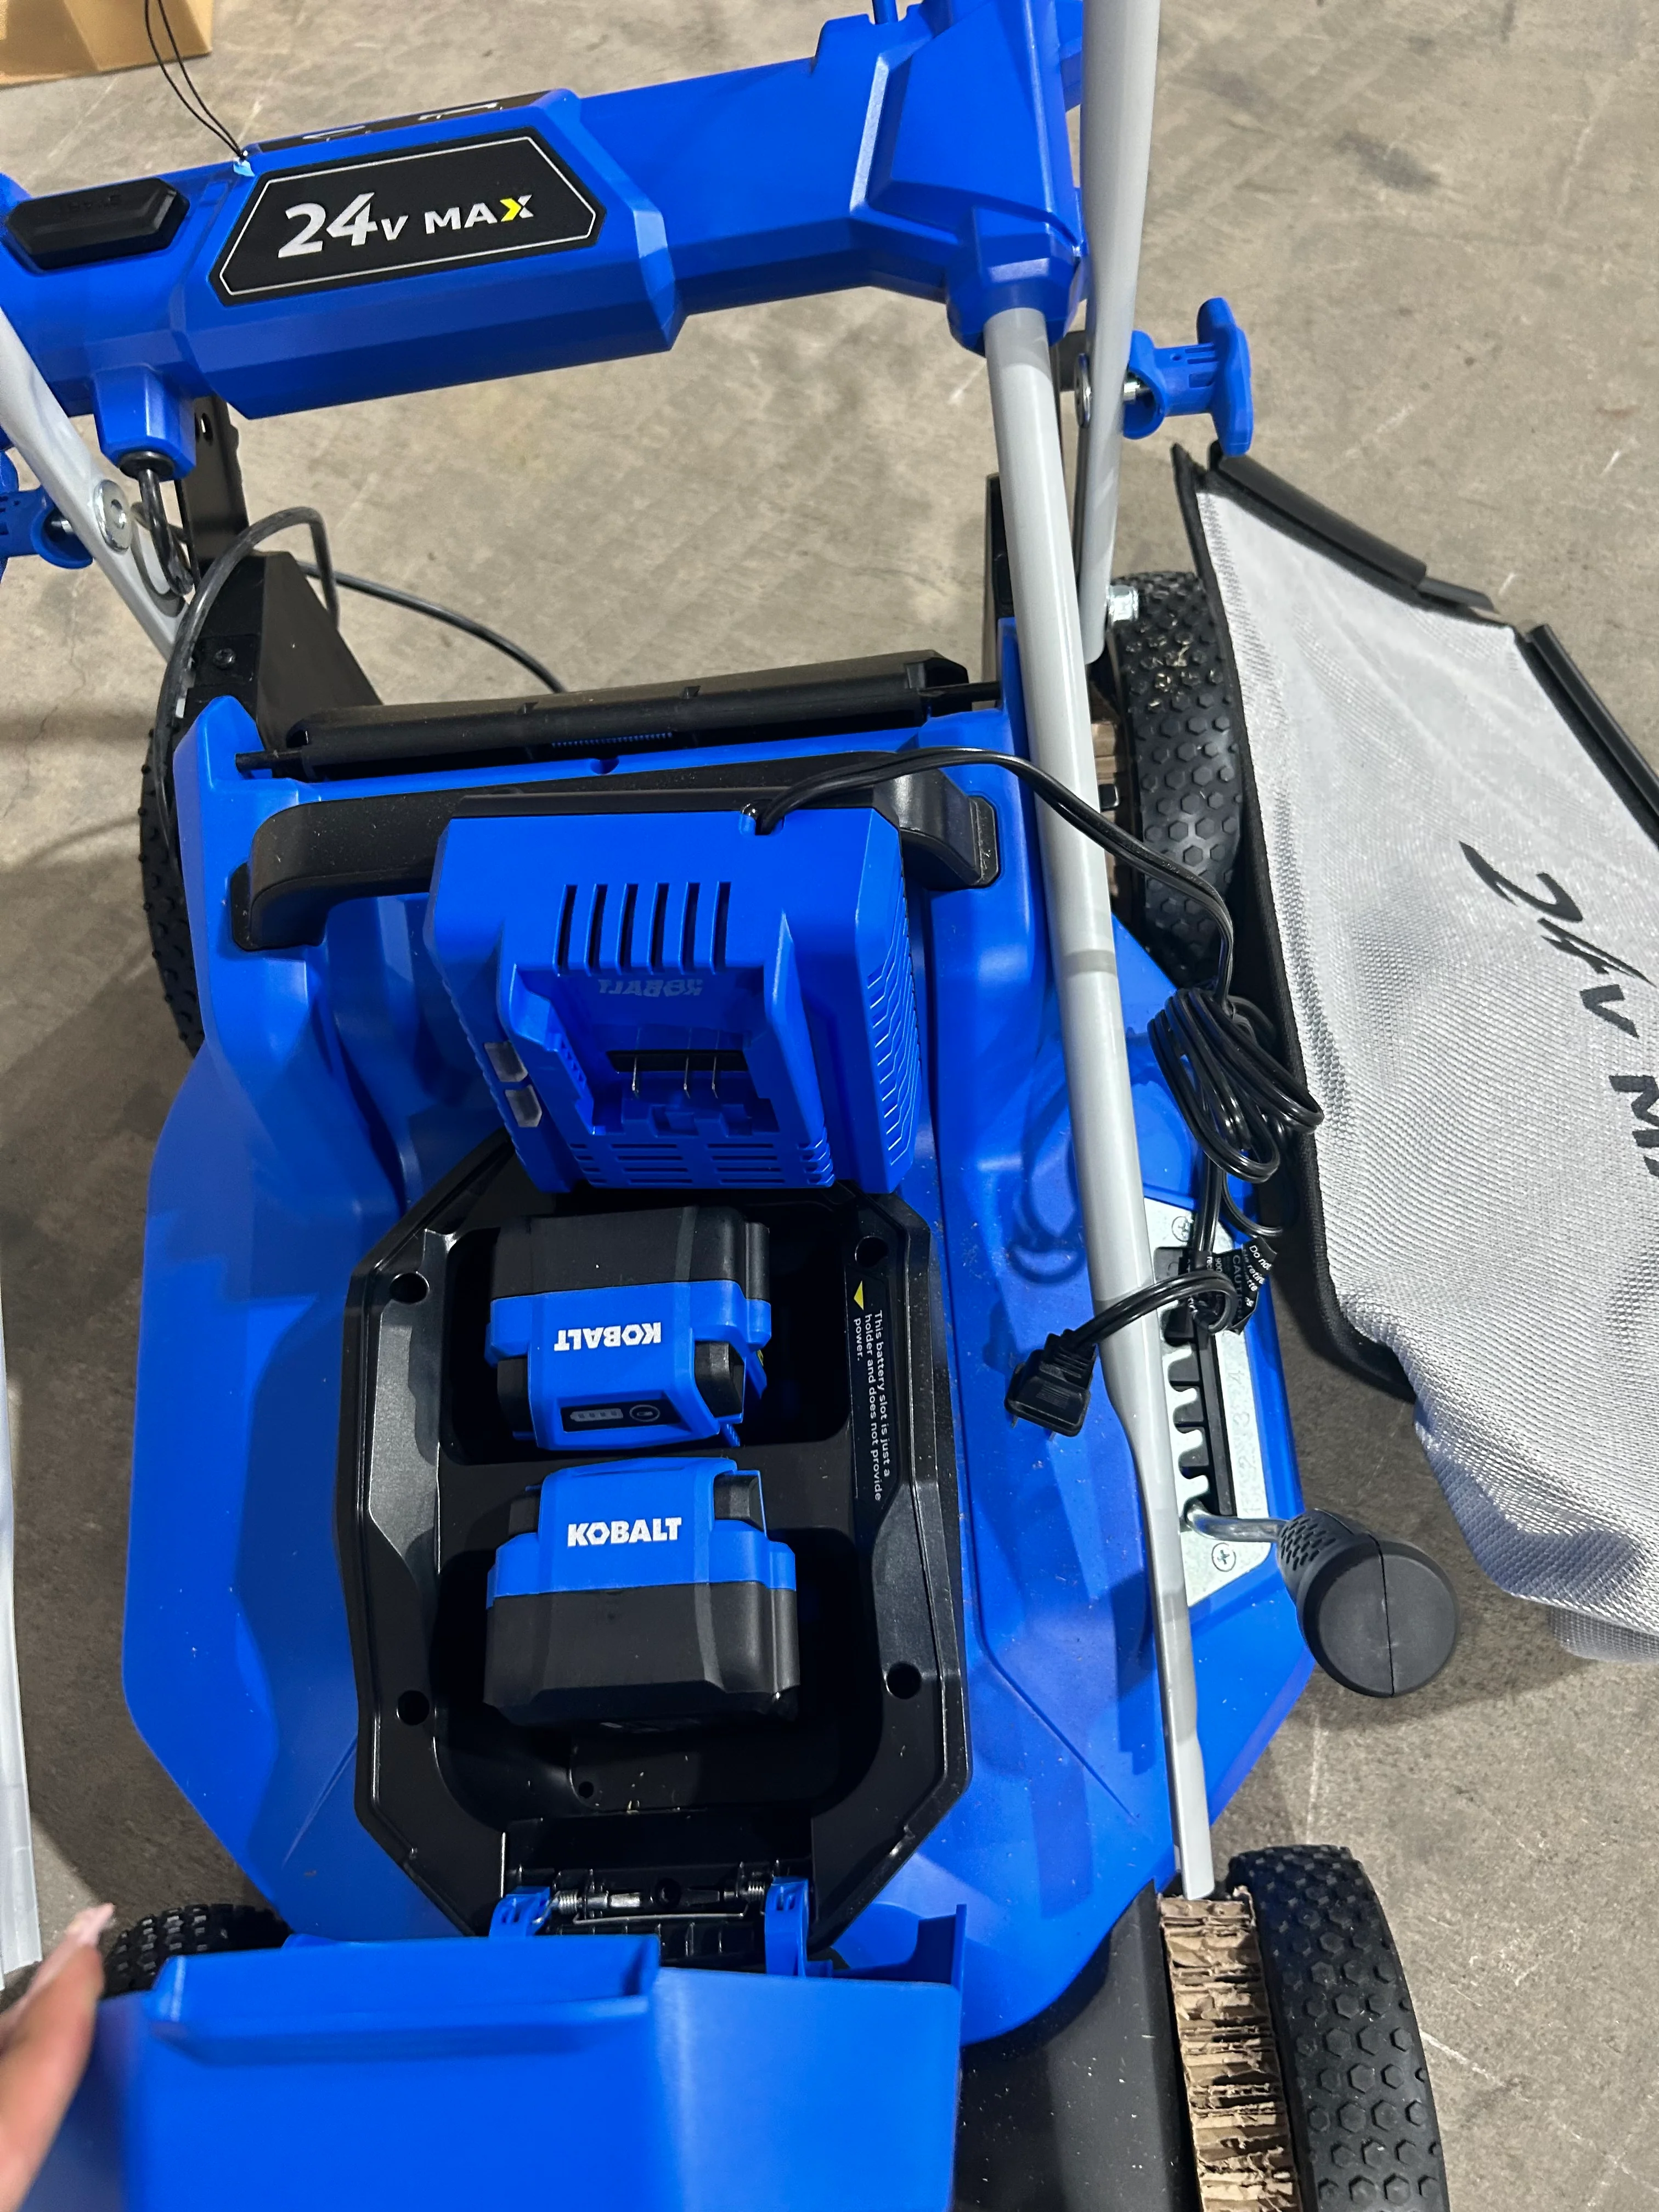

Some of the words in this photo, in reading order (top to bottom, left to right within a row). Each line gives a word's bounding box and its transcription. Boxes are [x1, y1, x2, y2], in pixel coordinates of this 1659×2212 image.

[424, 194, 534, 235] MAX
[1249, 1245, 1261, 1259] Do
[1258, 1258, 1272, 1271] not
[554, 1322, 662, 1352] KOBALT
[853, 1317, 864, 1362] power.
[865, 1313, 874, 1356] holder
[874, 1310, 883, 1339] This
[867, 1359, 876, 1384] and
[876, 1341, 885, 1391] battery
[868, 1386, 877, 1419] does
[879, 1394, 888, 1420] slot
[881, 1423, 889, 1436] is
[880, 1438, 890, 1465] just
[870, 1449, 883, 1502] provide
[883, 1469, 890, 1477] a
[567, 1517, 682, 1547] KOBALT
